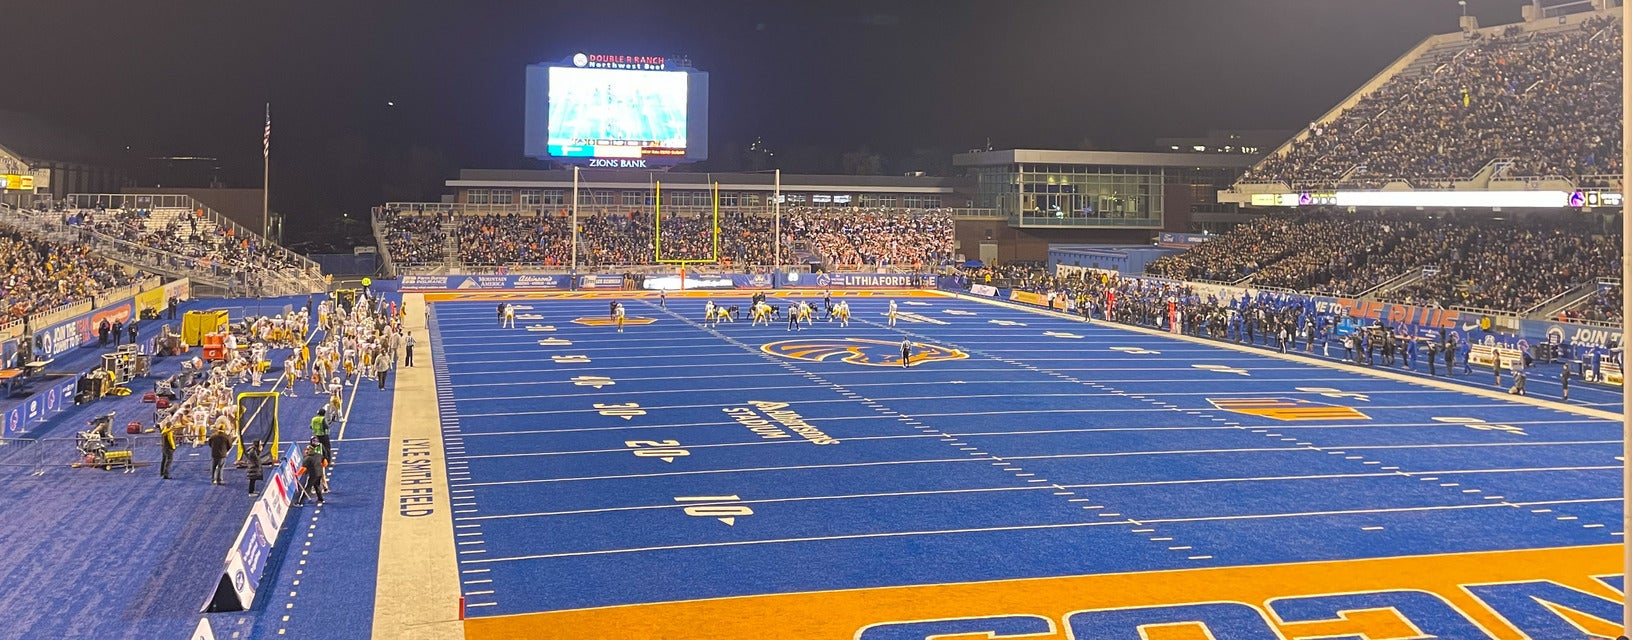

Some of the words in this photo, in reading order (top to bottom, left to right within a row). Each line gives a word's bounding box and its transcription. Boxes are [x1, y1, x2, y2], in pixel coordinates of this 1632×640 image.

[589, 54, 624, 63] DOUBLE
[634, 56, 665, 64] RANCH
[589, 61, 641, 69] Northwest
[589, 159, 619, 167] ZIONS
[620, 160, 647, 168] BANK
[1570, 328, 1608, 344] JOIN
[592, 402, 647, 416] 30
[722, 407, 792, 439] STADIUM
[402, 438, 431, 457] LYLE
[624, 439, 691, 457] 20
[400, 459, 433, 486] SMITH
[399, 487, 434, 517] FIELD
[674, 495, 754, 516] 10
